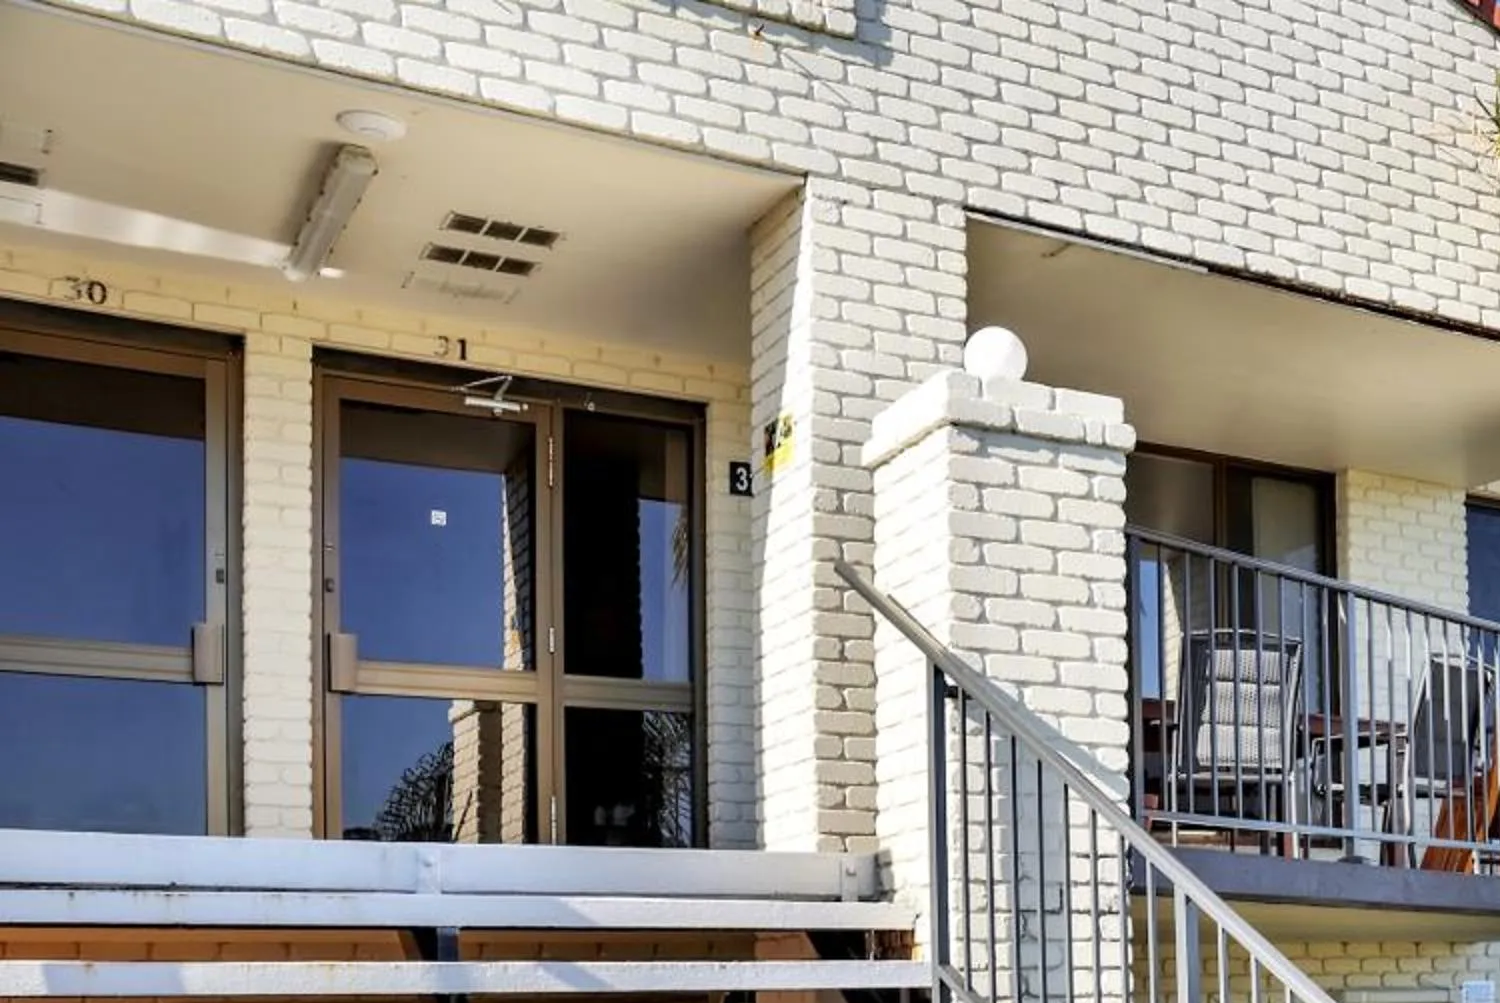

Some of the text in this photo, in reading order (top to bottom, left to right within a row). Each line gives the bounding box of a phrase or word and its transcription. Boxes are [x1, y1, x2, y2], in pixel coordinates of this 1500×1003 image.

[64, 276, 107, 305] 30
[433, 335, 467, 361] 31
[735, 467, 753, 491] 3
